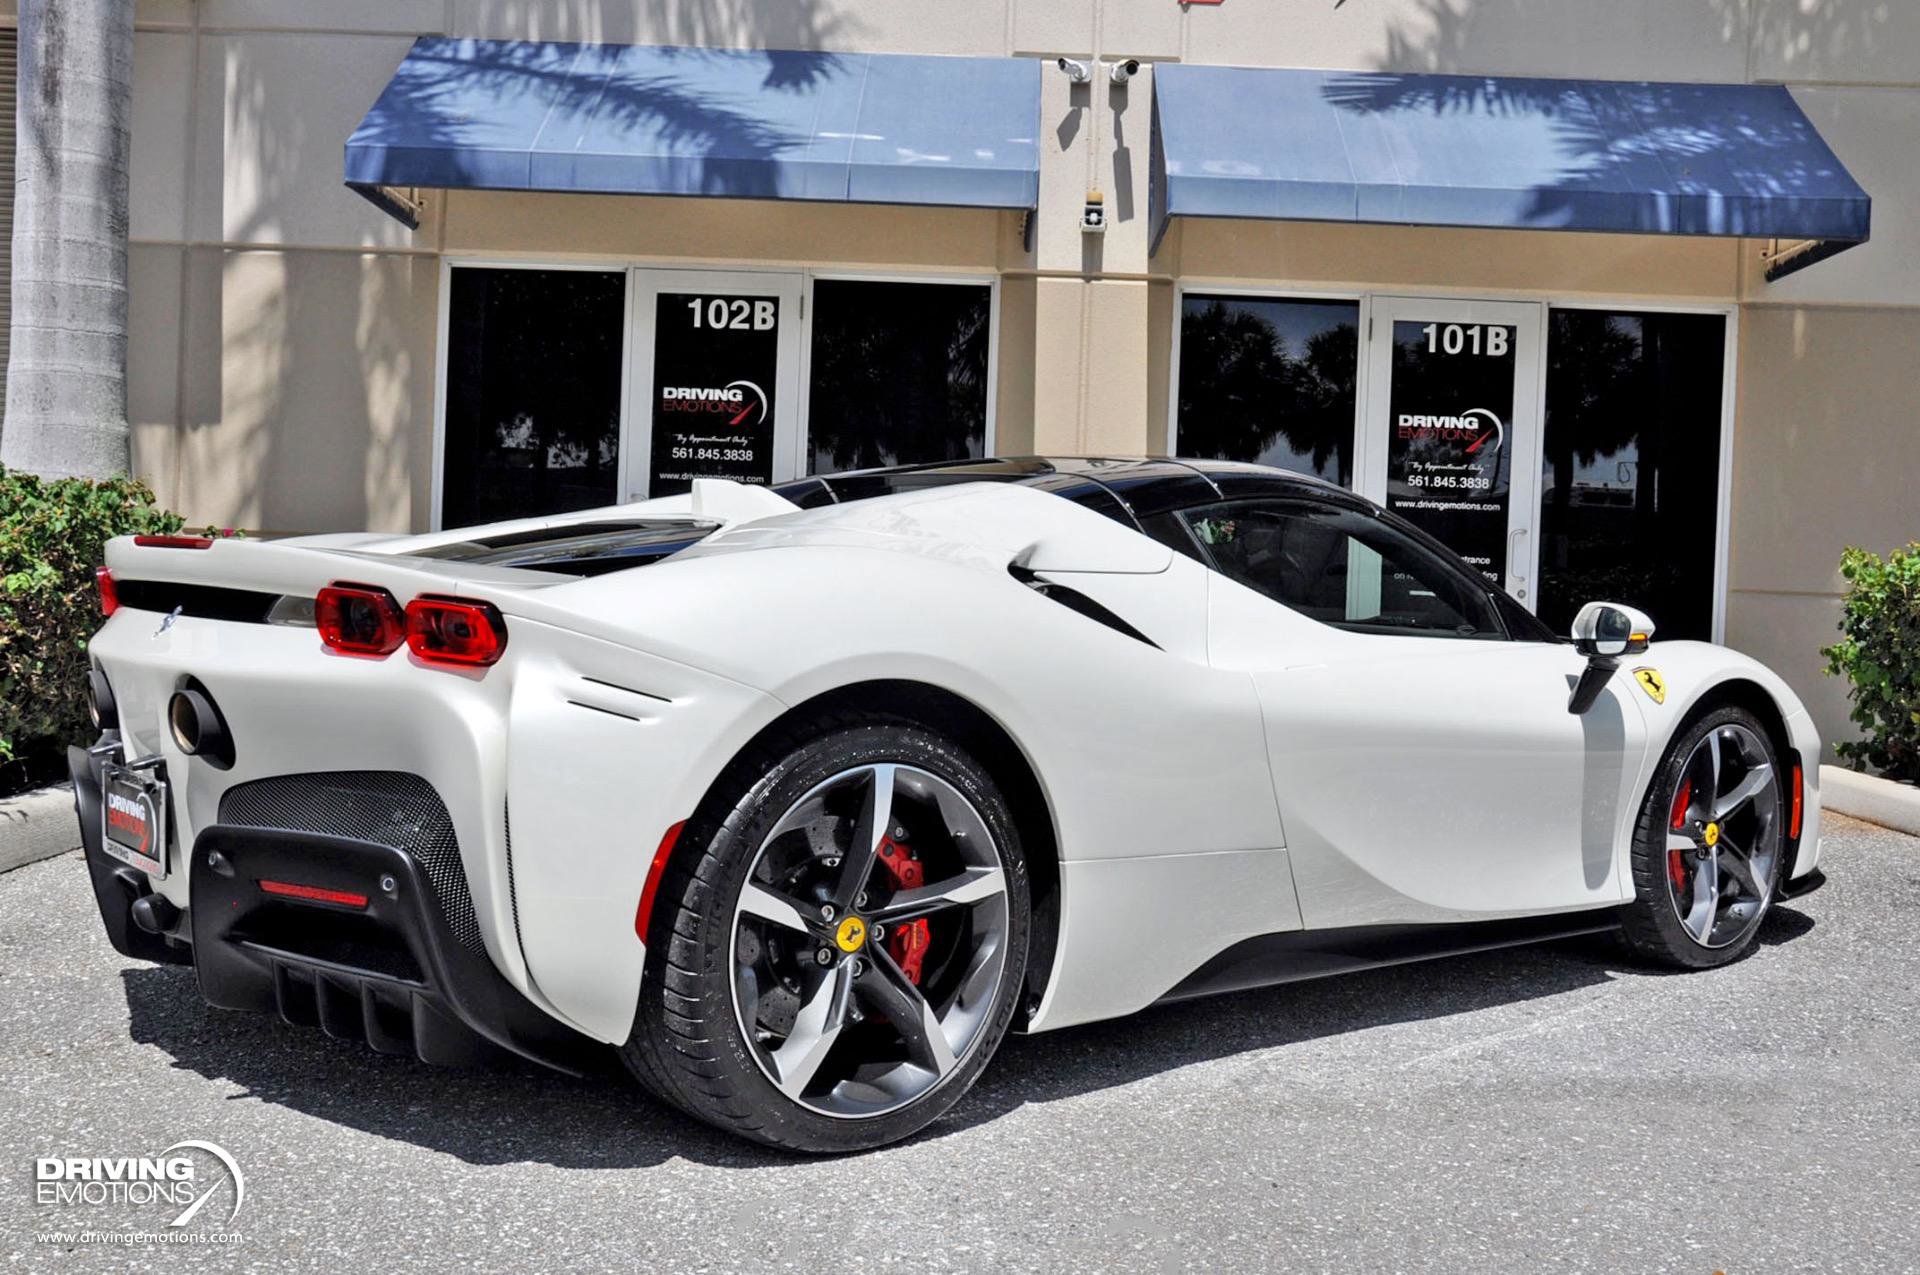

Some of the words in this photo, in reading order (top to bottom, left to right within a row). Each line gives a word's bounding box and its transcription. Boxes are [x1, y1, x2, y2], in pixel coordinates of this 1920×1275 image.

[688, 298, 775, 331] 102B
[1422, 323, 1508, 357] 101B
[663, 387, 743, 401] DRIVING
[663, 400, 743, 413] EMOTIONS
[1398, 414, 1479, 429] DRIVING
[688, 433, 731, 444] Appointment
[1398, 427, 1479, 440] EMOTIONS
[672, 447, 754, 461] 561.845.3838
[1424, 461, 1468, 472] Appointment
[1407, 475, 1490, 489] 561.845.3838
[1395, 500, 1501, 511] www.drivingemotions.com
[108, 792, 145, 821] DRIVING
